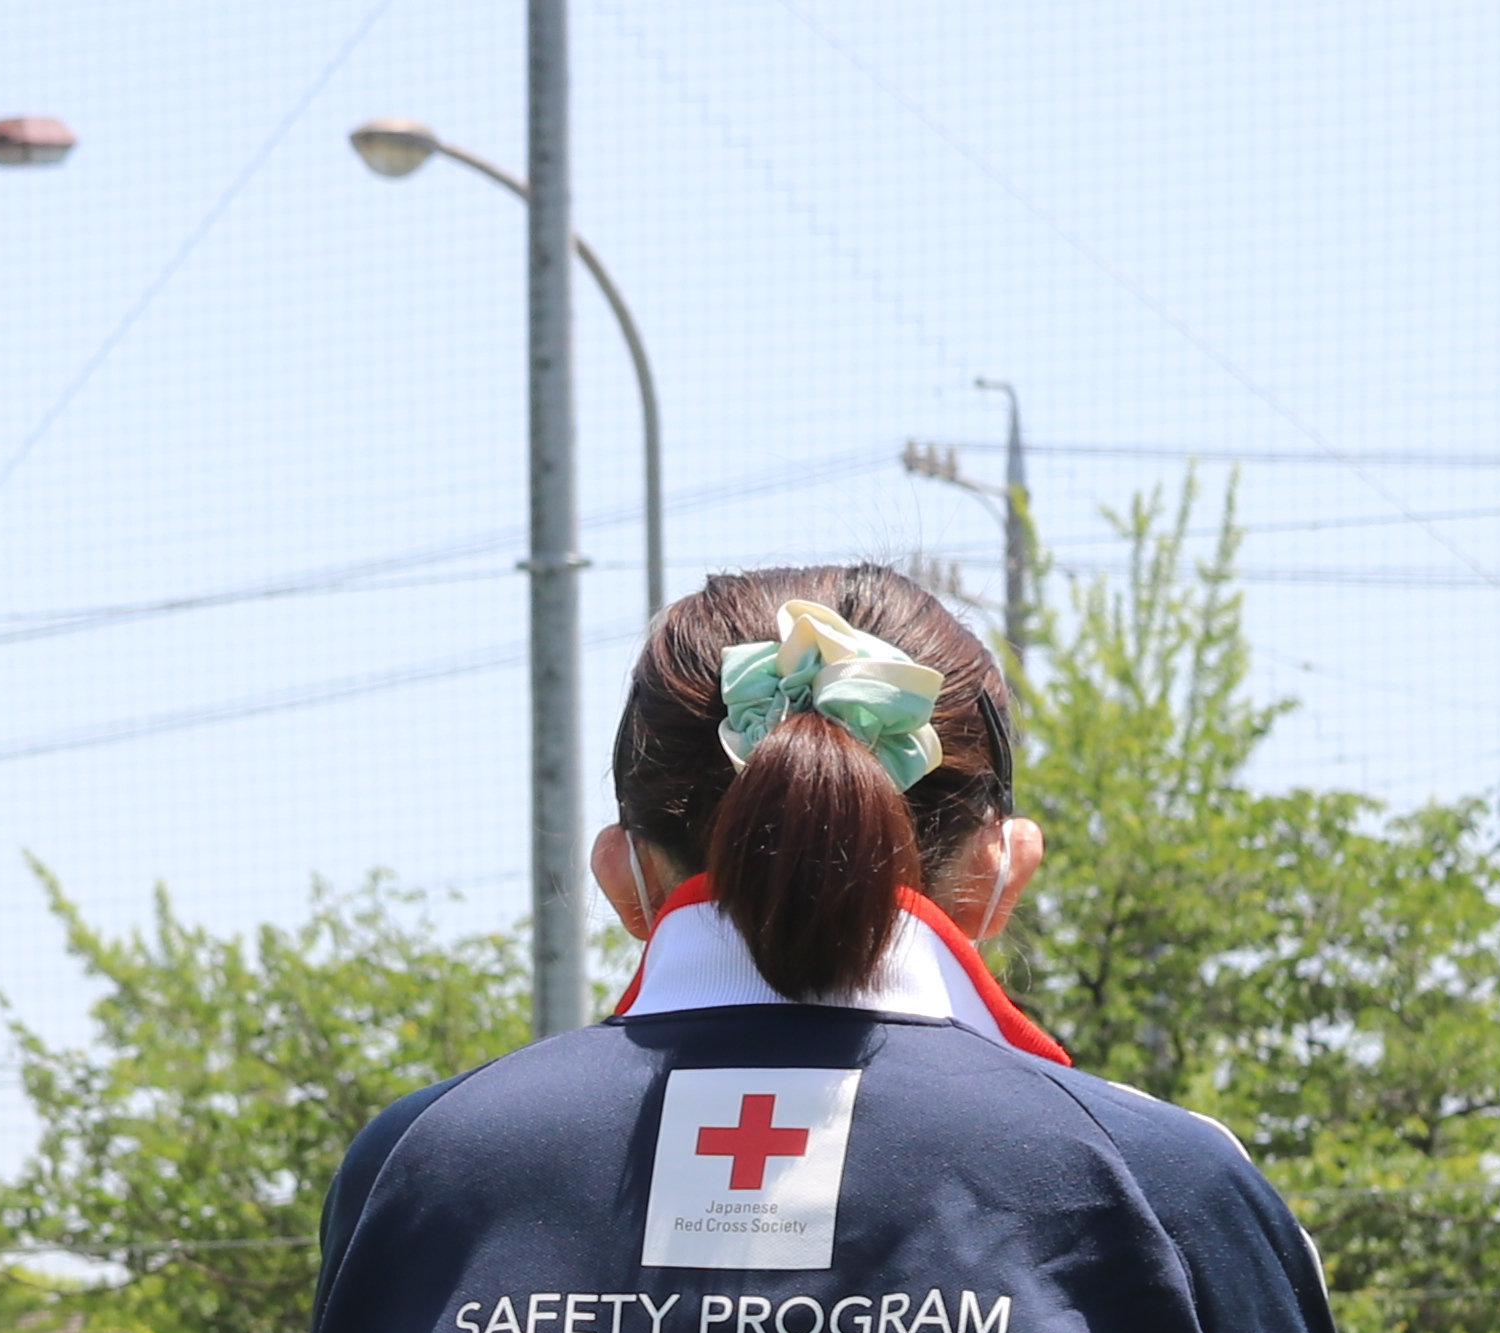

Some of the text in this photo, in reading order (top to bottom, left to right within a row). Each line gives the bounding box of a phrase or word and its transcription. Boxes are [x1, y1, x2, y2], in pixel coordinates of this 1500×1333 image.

[705, 1200, 779, 1216] Japanese
[674, 1217, 808, 1234] Red Cross Society
